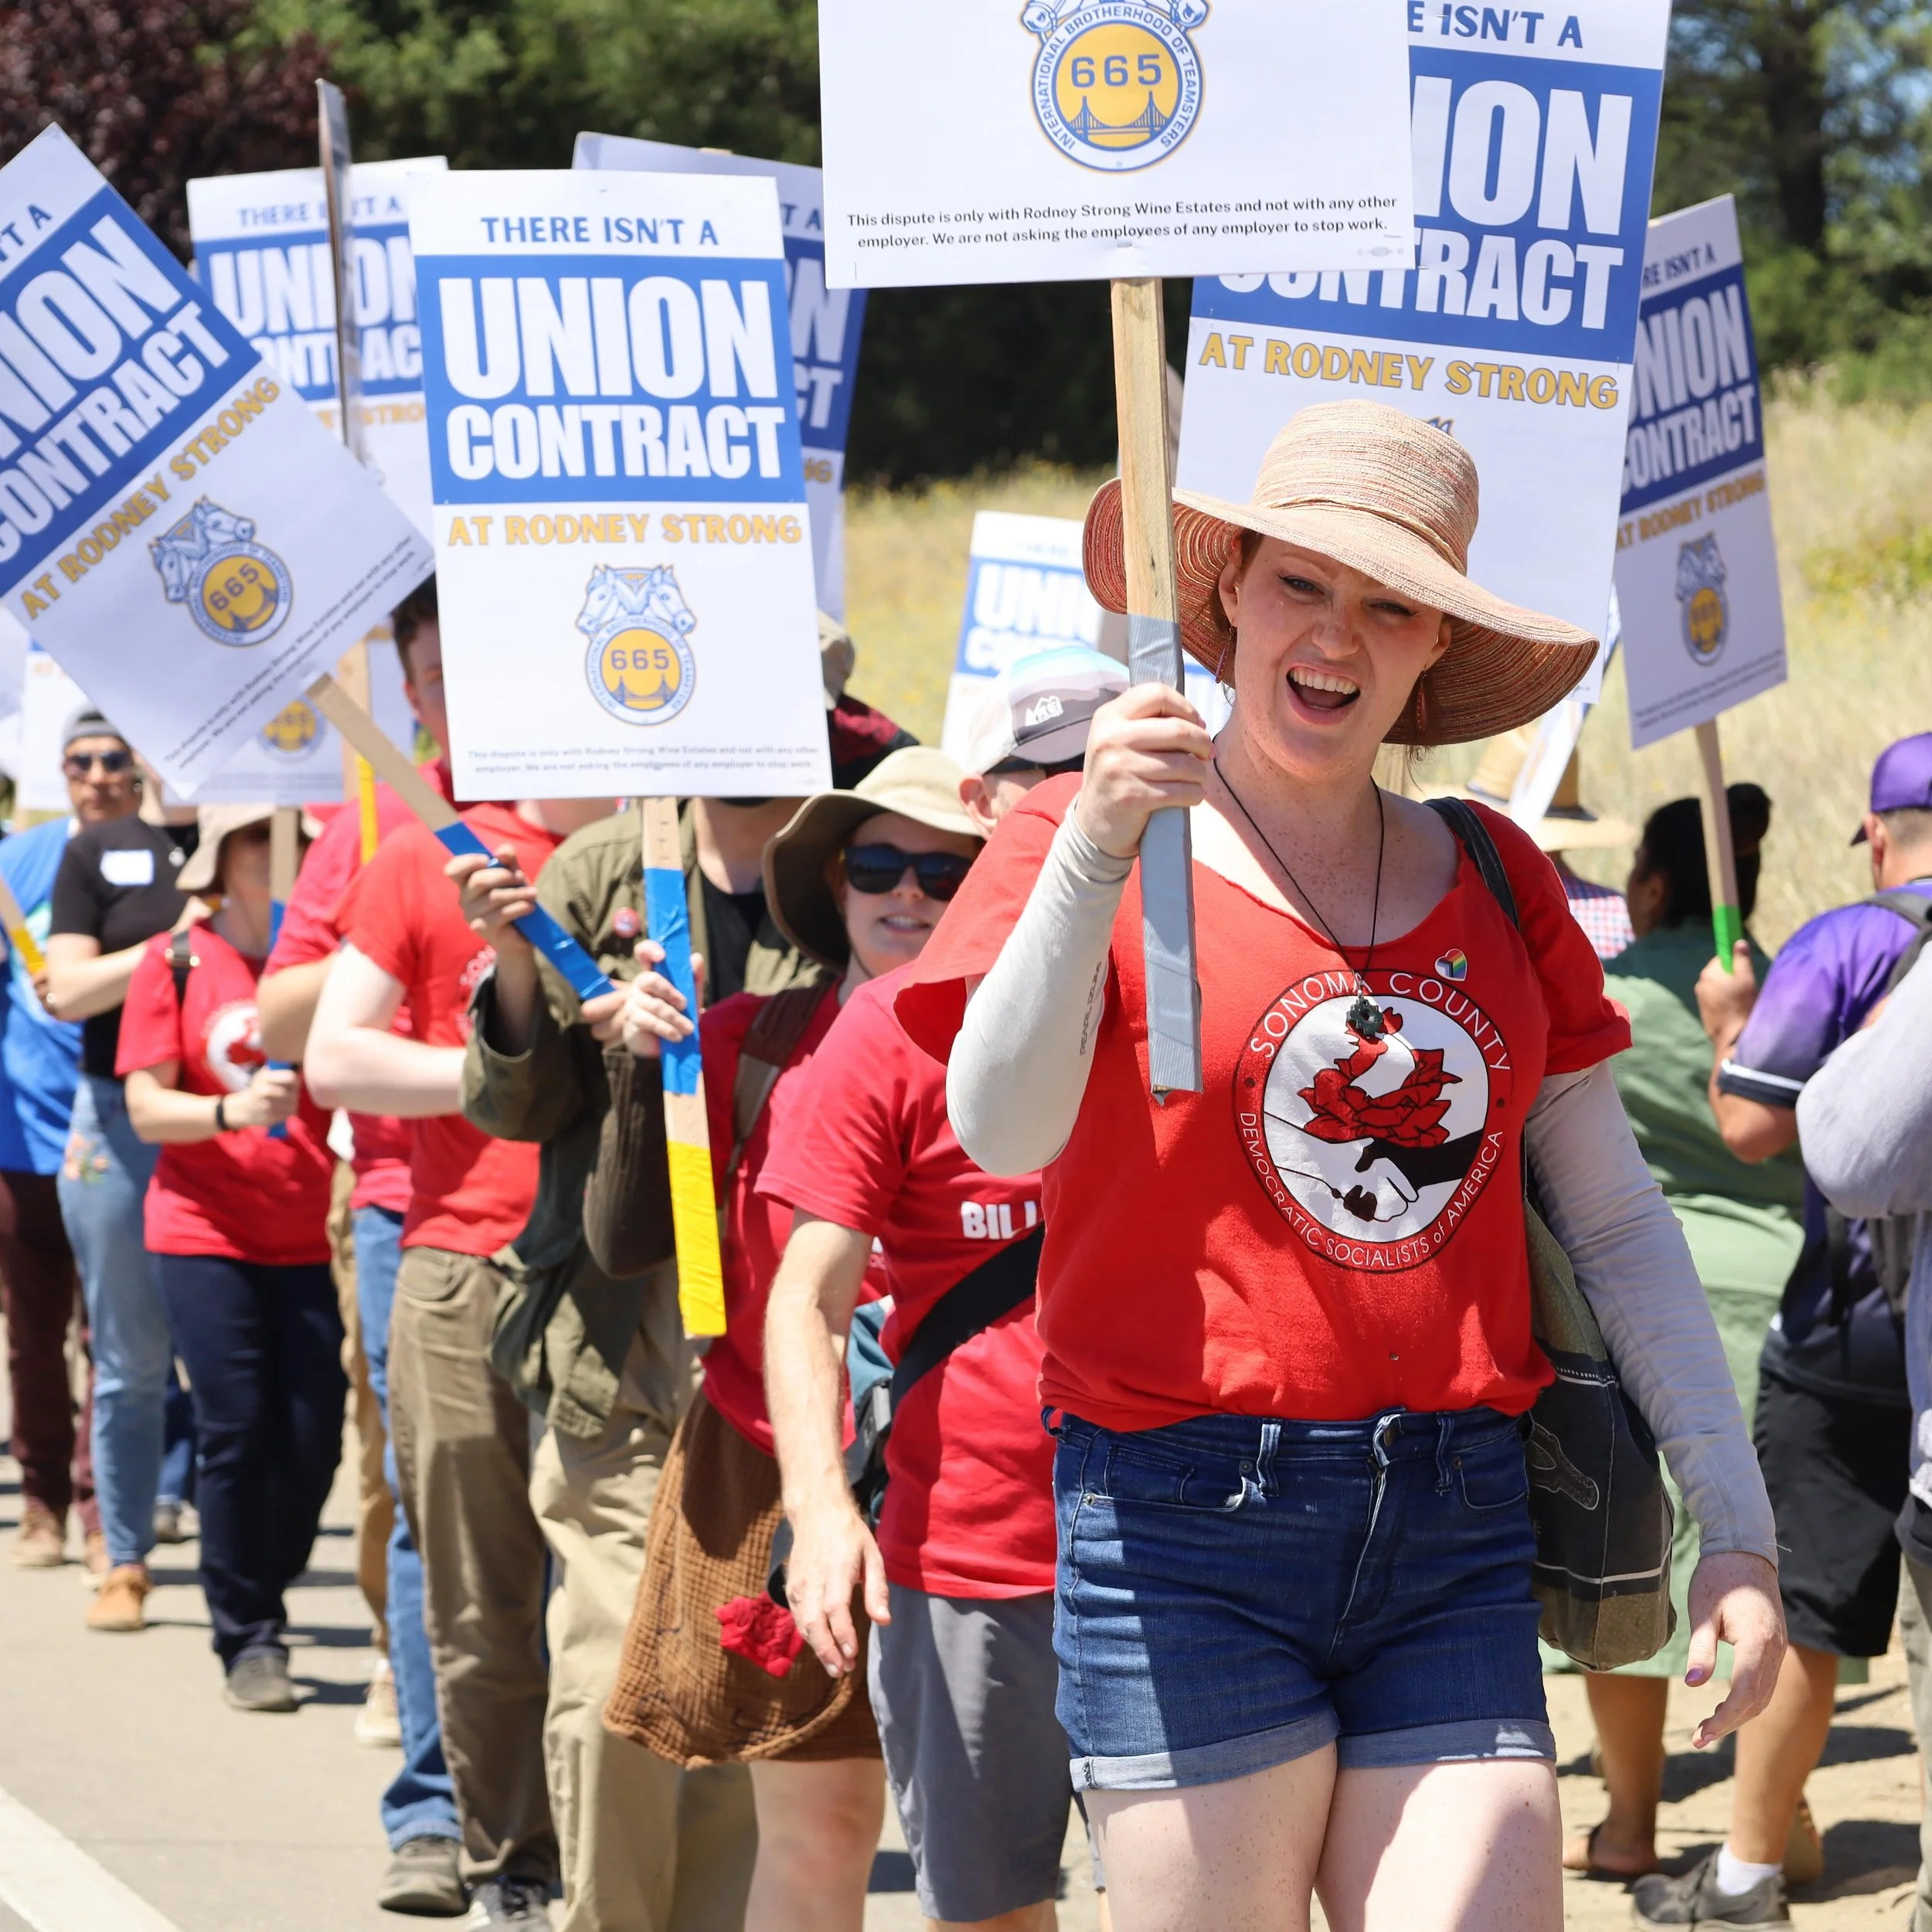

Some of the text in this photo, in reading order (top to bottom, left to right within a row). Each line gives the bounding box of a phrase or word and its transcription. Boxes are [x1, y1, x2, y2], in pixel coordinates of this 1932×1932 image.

[1441, 3, 1545, 44] ISN'T
[1556, 15, 1583, 48] A
[1038, 5, 1196, 150] INTERNATIONAL BROTHERHOOD OF TEAMSTERS
[1071, 53, 1162, 87] 665
[1412, 75, 1633, 236] ION
[28, 203, 52, 230] A
[481, 216, 719, 246] THERE ISN'T A
[848, 196, 1397, 226] This dispute is only with Rodney Strong Wine Estates and not with any other
[858, 217, 1387, 248] employer. We are not asking the employees of any employer to stop work.
[0, 214, 182, 459] ION
[438, 276, 778, 400] UNION
[1199, 332, 1619, 410] AT RODNEY STRONG
[1629, 283, 1751, 423] NION
[447, 403, 785, 480] CONTRACT
[21, 376, 280, 621] AT RODNEY STRONG
[449, 514, 802, 546] AT RODNEY STRONG
[209, 563, 260, 611] 665
[975, 564, 1101, 645] UNI
[611, 648, 670, 670] 665
[1250, 971, 1511, 1072] SONOMA COUNTY
[1240, 1111, 1504, 1268] DEMOCRATIC SOCIALISTS of AMERICA
